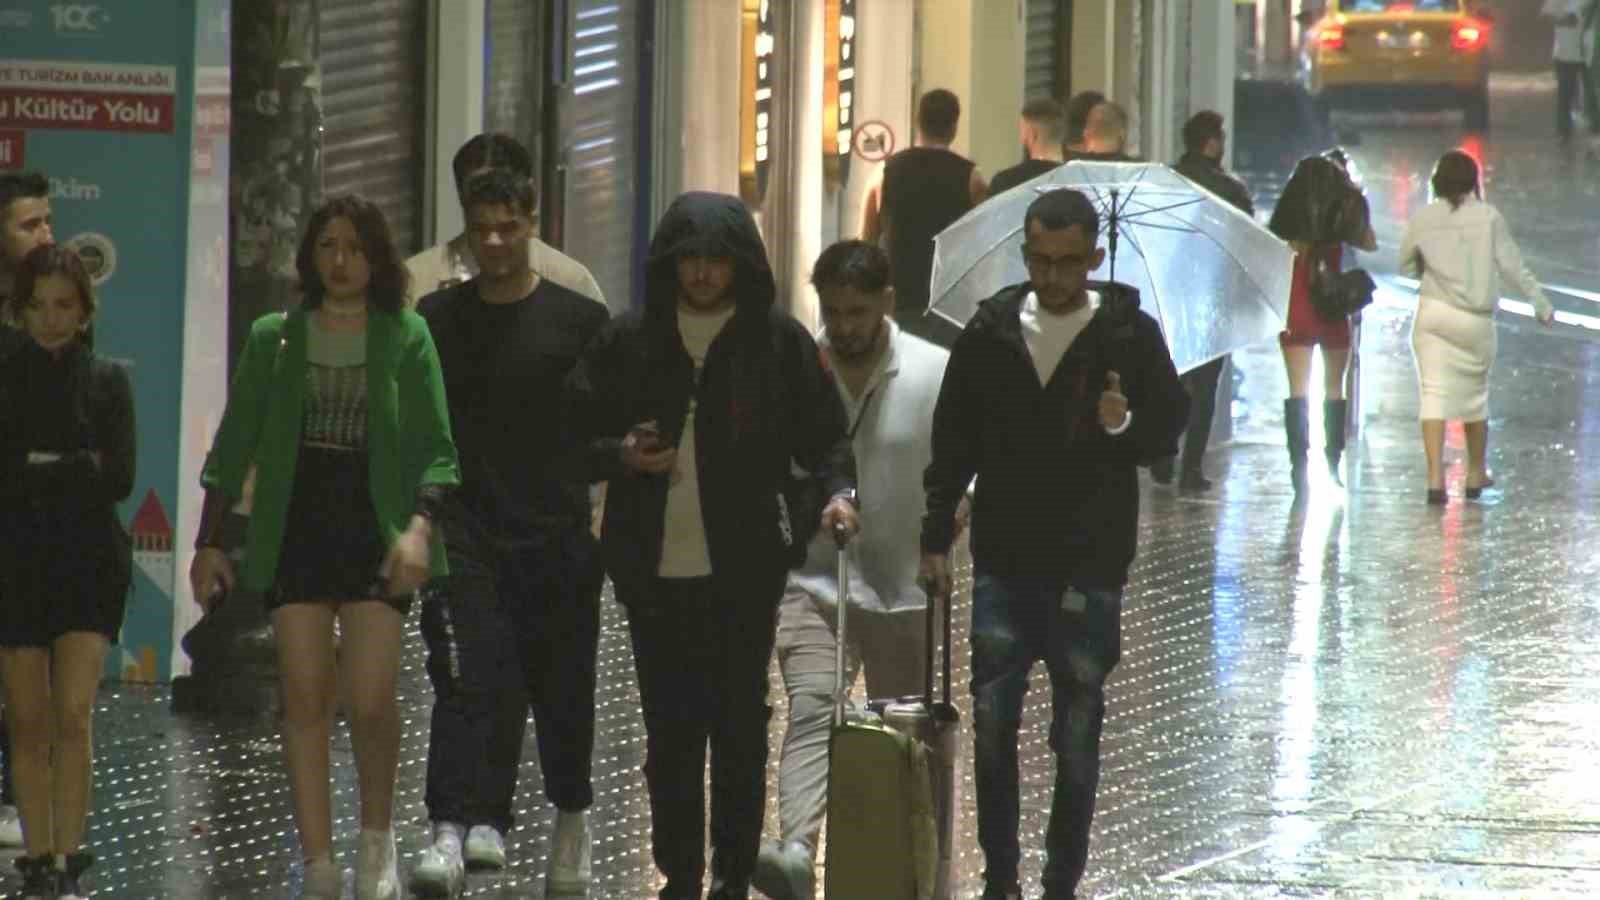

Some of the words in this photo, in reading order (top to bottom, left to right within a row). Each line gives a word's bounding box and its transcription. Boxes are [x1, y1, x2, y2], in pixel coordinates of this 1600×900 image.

[19, 68, 79, 82] TURİZM
[82, 71, 169, 87] BAKANLIĞI
[14, 97, 97, 121] Kültür
[103, 101, 160, 124] Yolu
